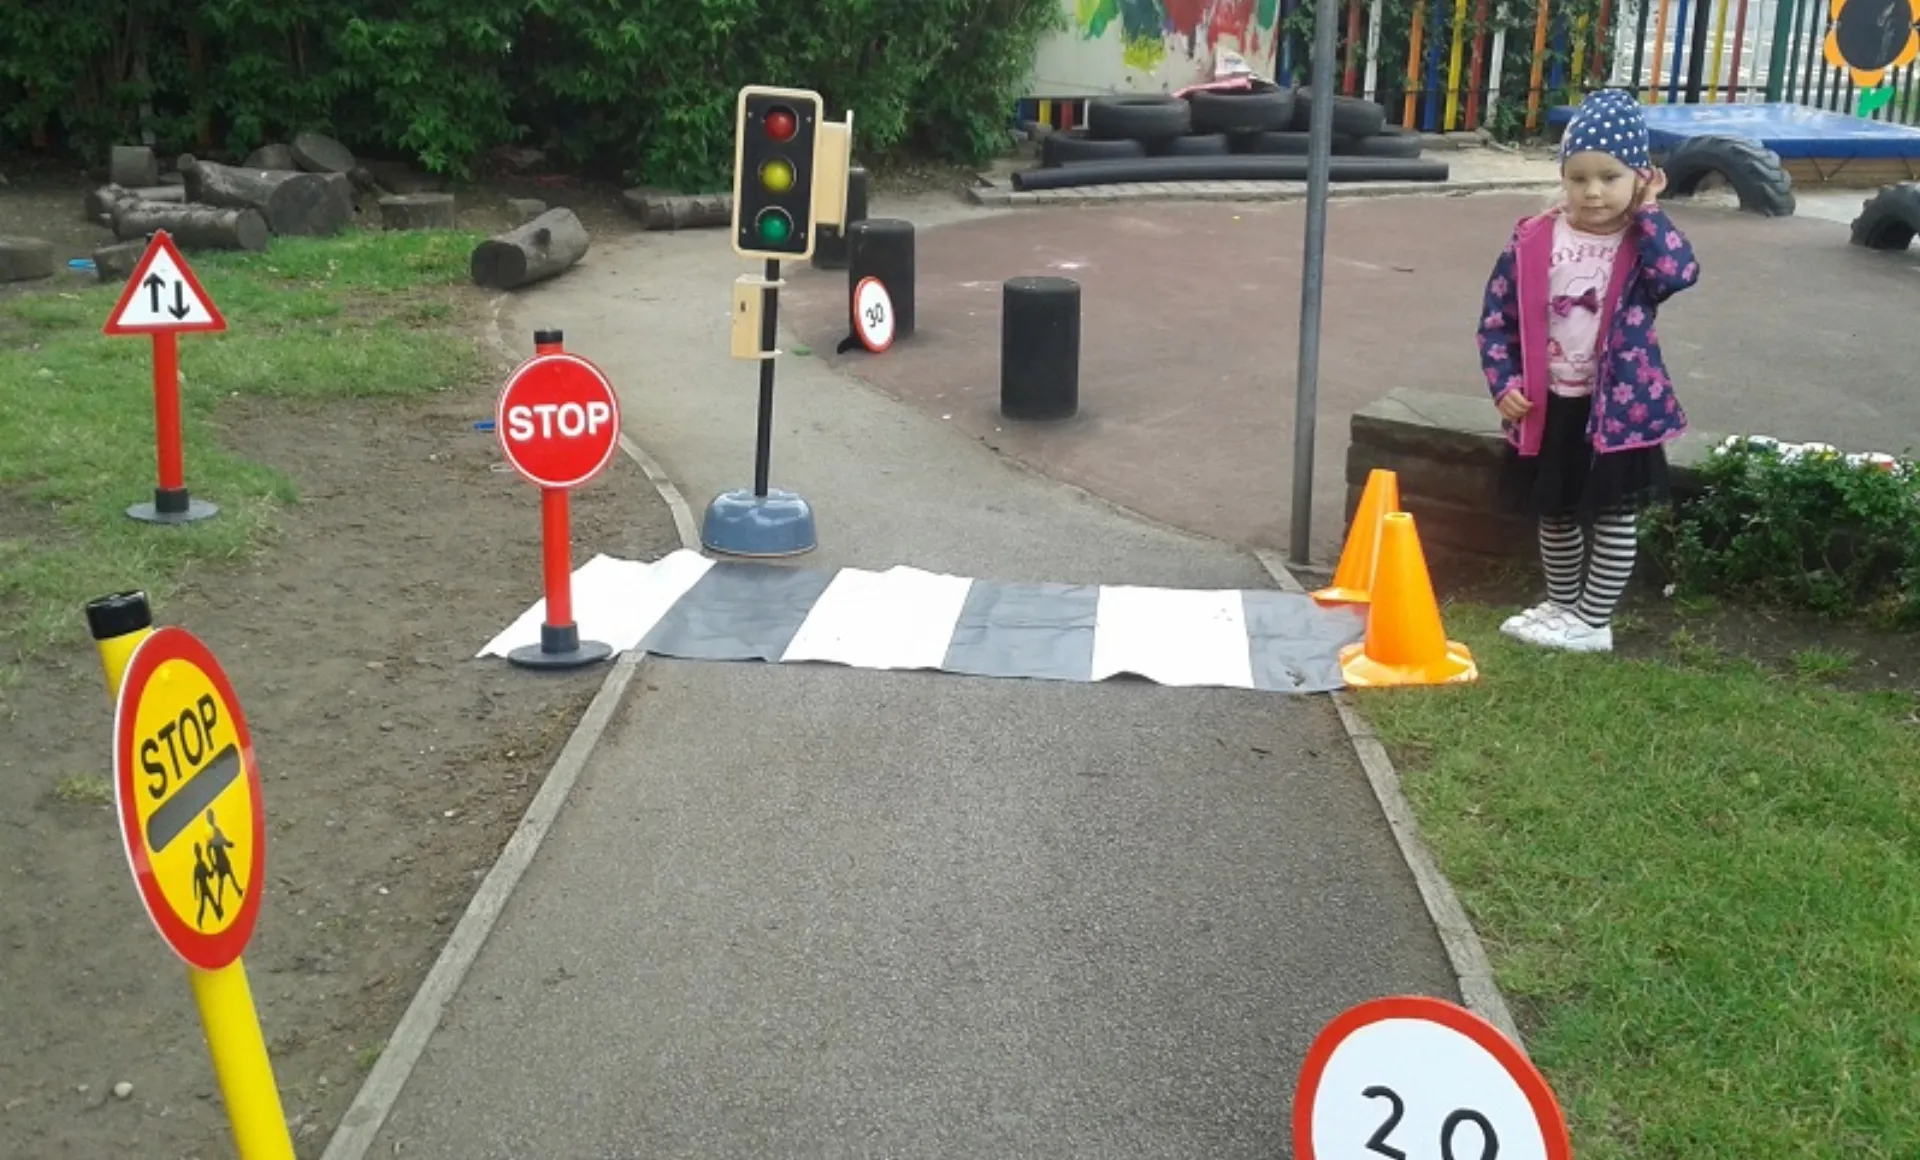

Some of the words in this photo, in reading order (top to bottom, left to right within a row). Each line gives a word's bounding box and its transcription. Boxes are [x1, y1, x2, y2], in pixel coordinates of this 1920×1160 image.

[866, 302, 884, 329] 30
[508, 401, 610, 441] STOP
[141, 692, 217, 800] STOP
[1361, 1085, 1499, 1160] 20
